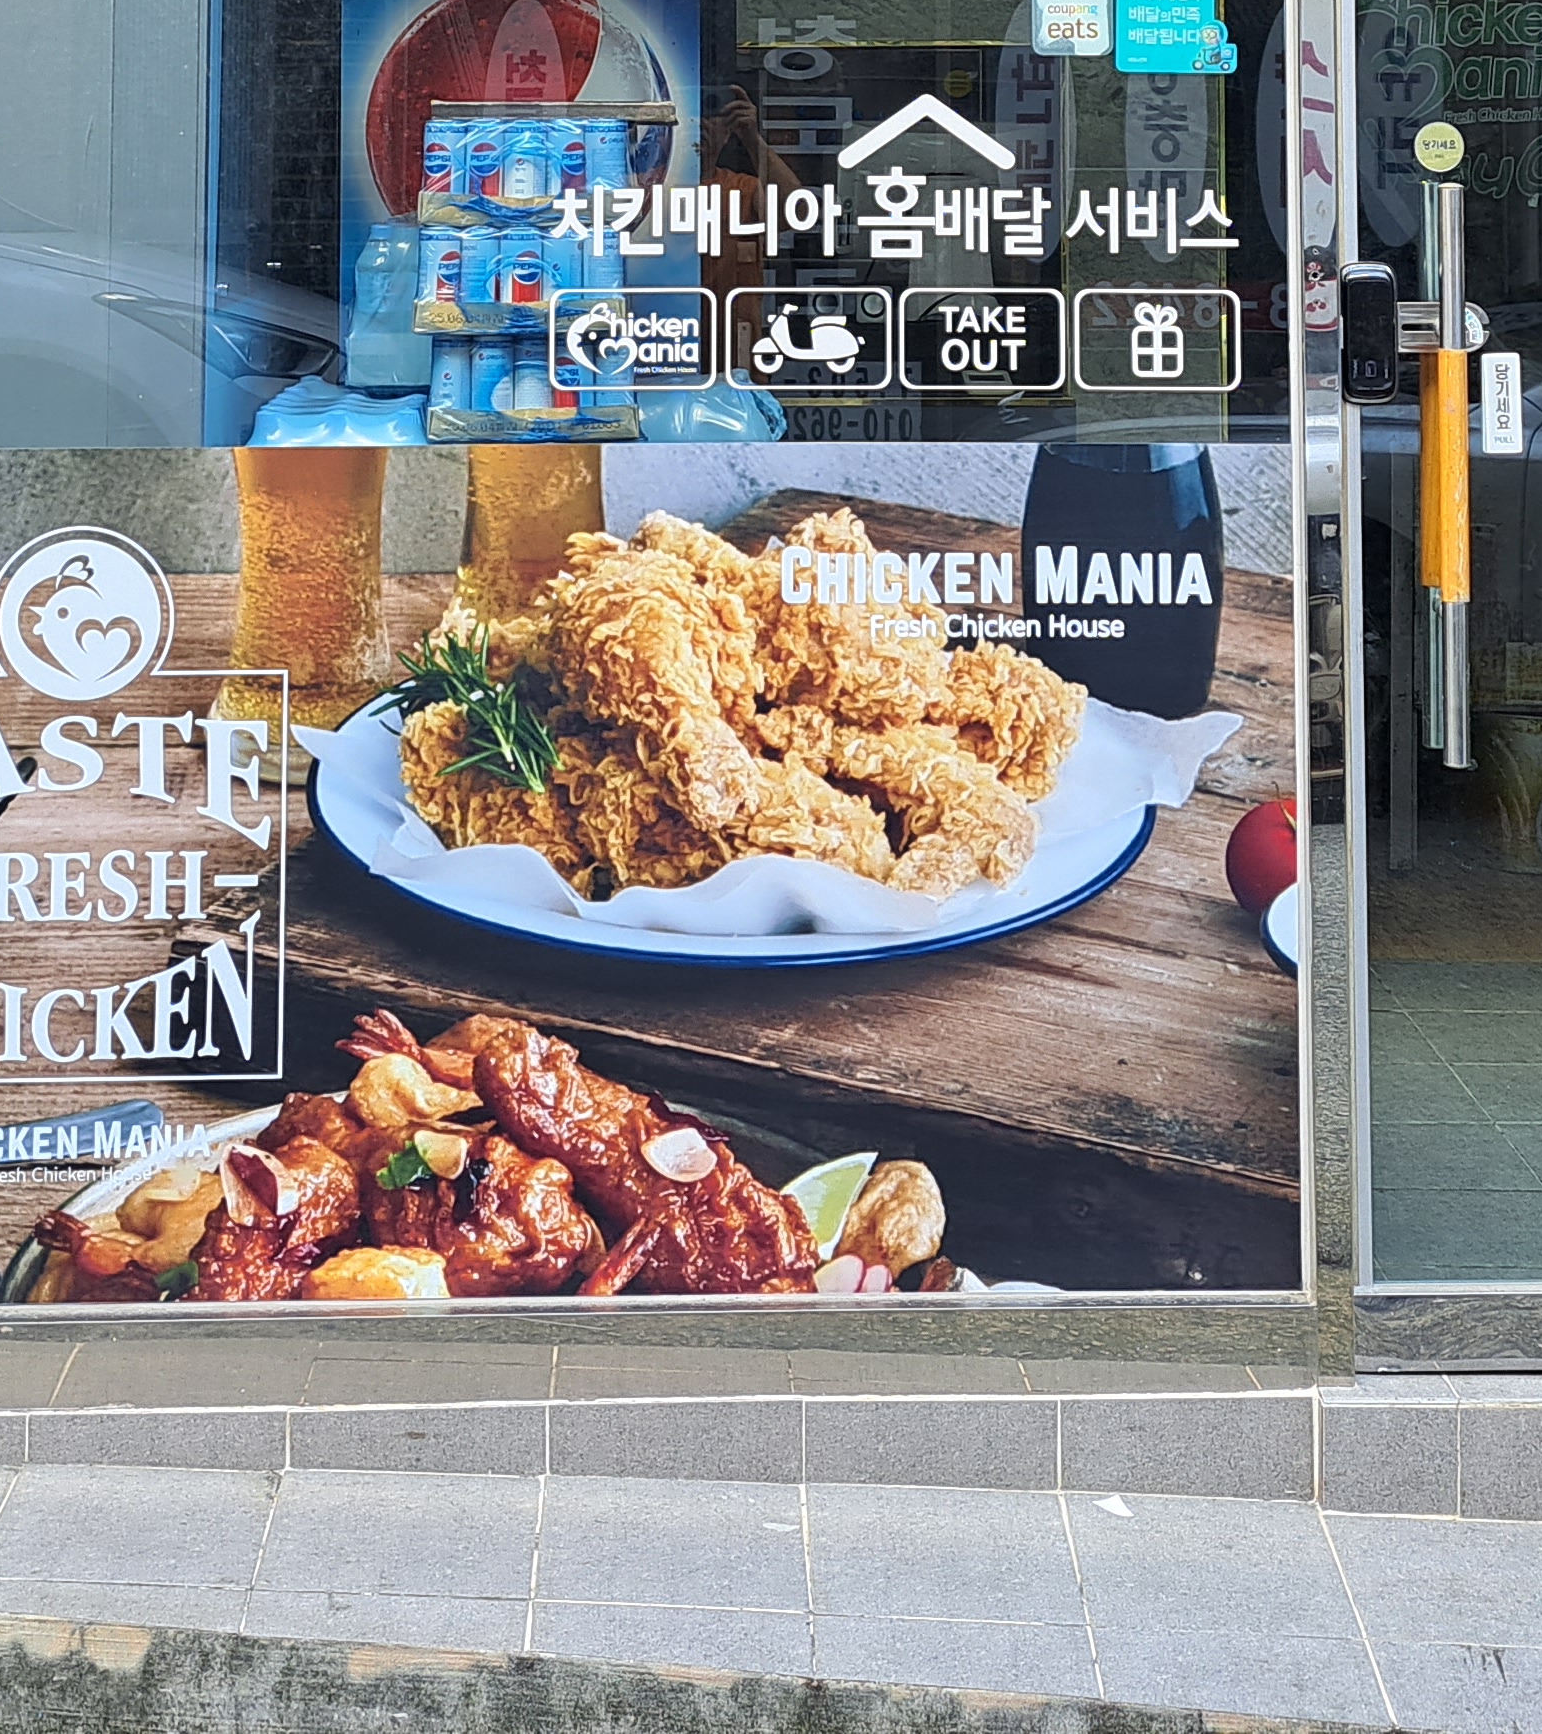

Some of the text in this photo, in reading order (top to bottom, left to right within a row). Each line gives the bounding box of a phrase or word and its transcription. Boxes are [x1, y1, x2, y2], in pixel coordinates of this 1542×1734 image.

[1047, 5, 1098, 16] coupang
[1128, 6, 1200, 23] 배달의민족
[1047, 19, 1099, 39] eats
[1128, 29, 1201, 44] 배달됩니다
[1422, 139, 1456, 150] 당기세요
[551, 184, 843, 256] 치킨매니아
[858, 166, 1052, 259] 홈배달
[1066, 186, 1240, 255] 서비스
[939, 306, 1027, 333] TAKE
[940, 339, 1027, 372] OUT
[1494, 363, 1511, 430] 당기세요
[781, 545, 1213, 605] CHICKEN MANIA
[869, 614, 1126, 639] Fresh Chicken House
[93, 1120, 210, 1159] MANIA
[31, 1167, 96, 1182] Chicken
